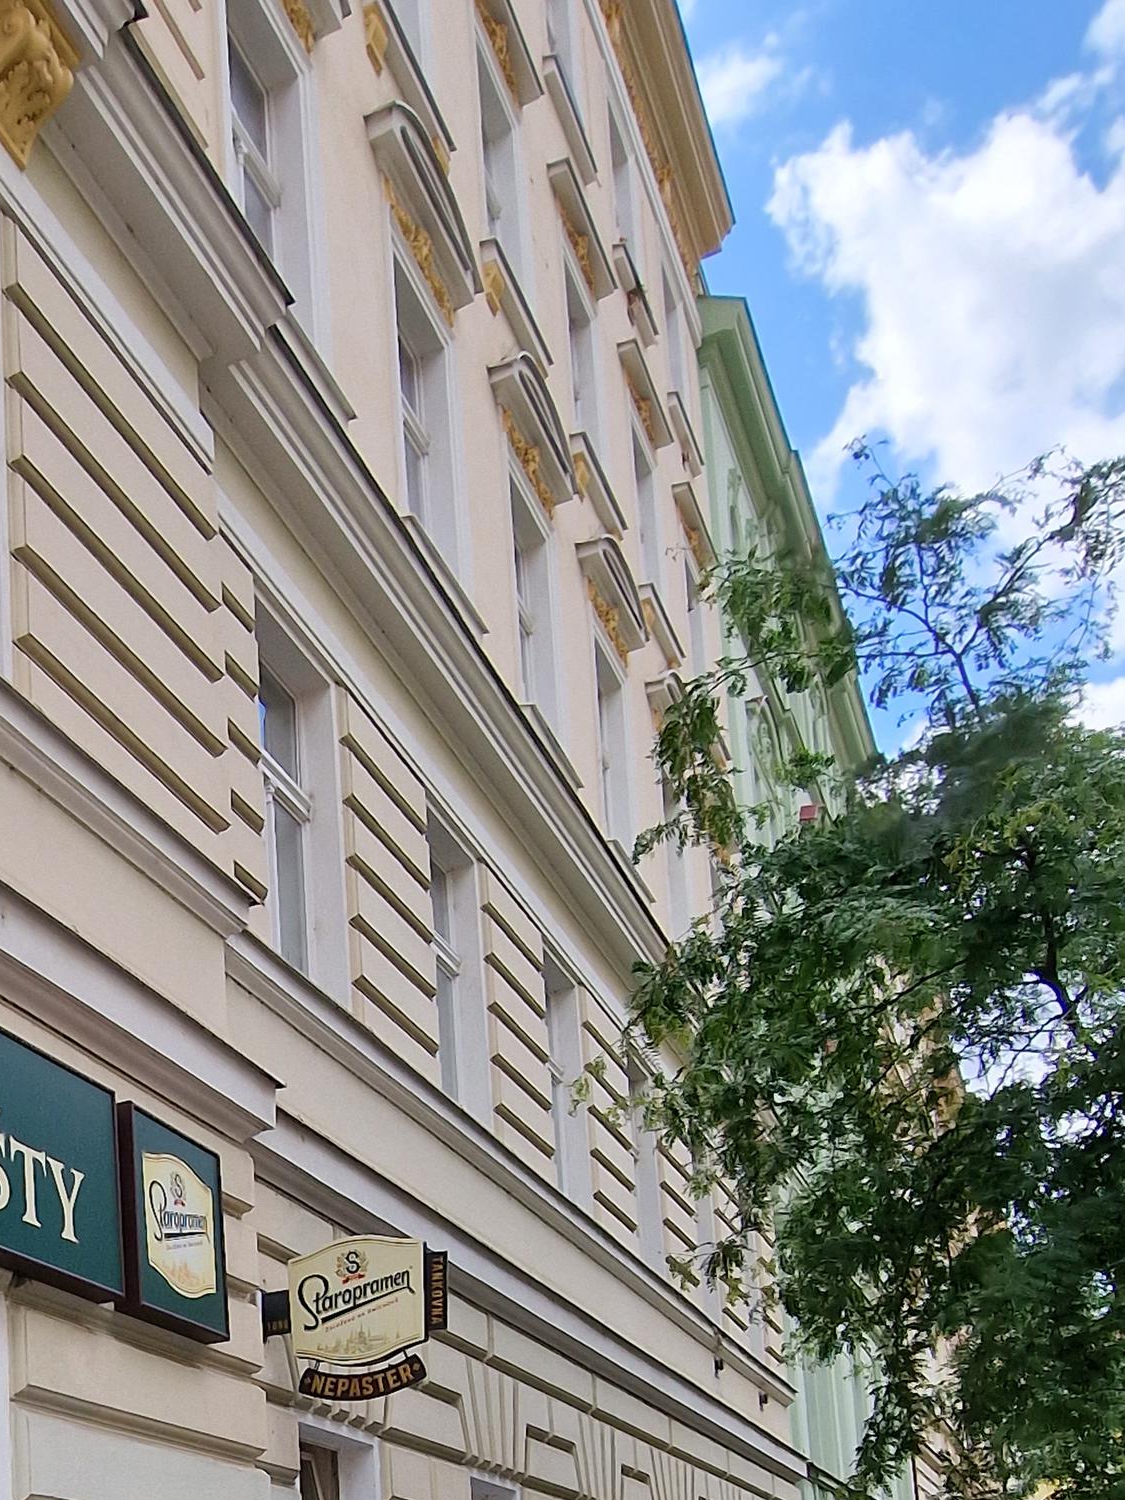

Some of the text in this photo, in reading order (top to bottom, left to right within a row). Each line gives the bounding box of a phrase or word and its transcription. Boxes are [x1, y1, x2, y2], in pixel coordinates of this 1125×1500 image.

[149, 1180, 210, 1244] Staropramen
[298, 1270, 415, 1332] Staropramen
[310, 1363, 415, 1398] NEPASTER
